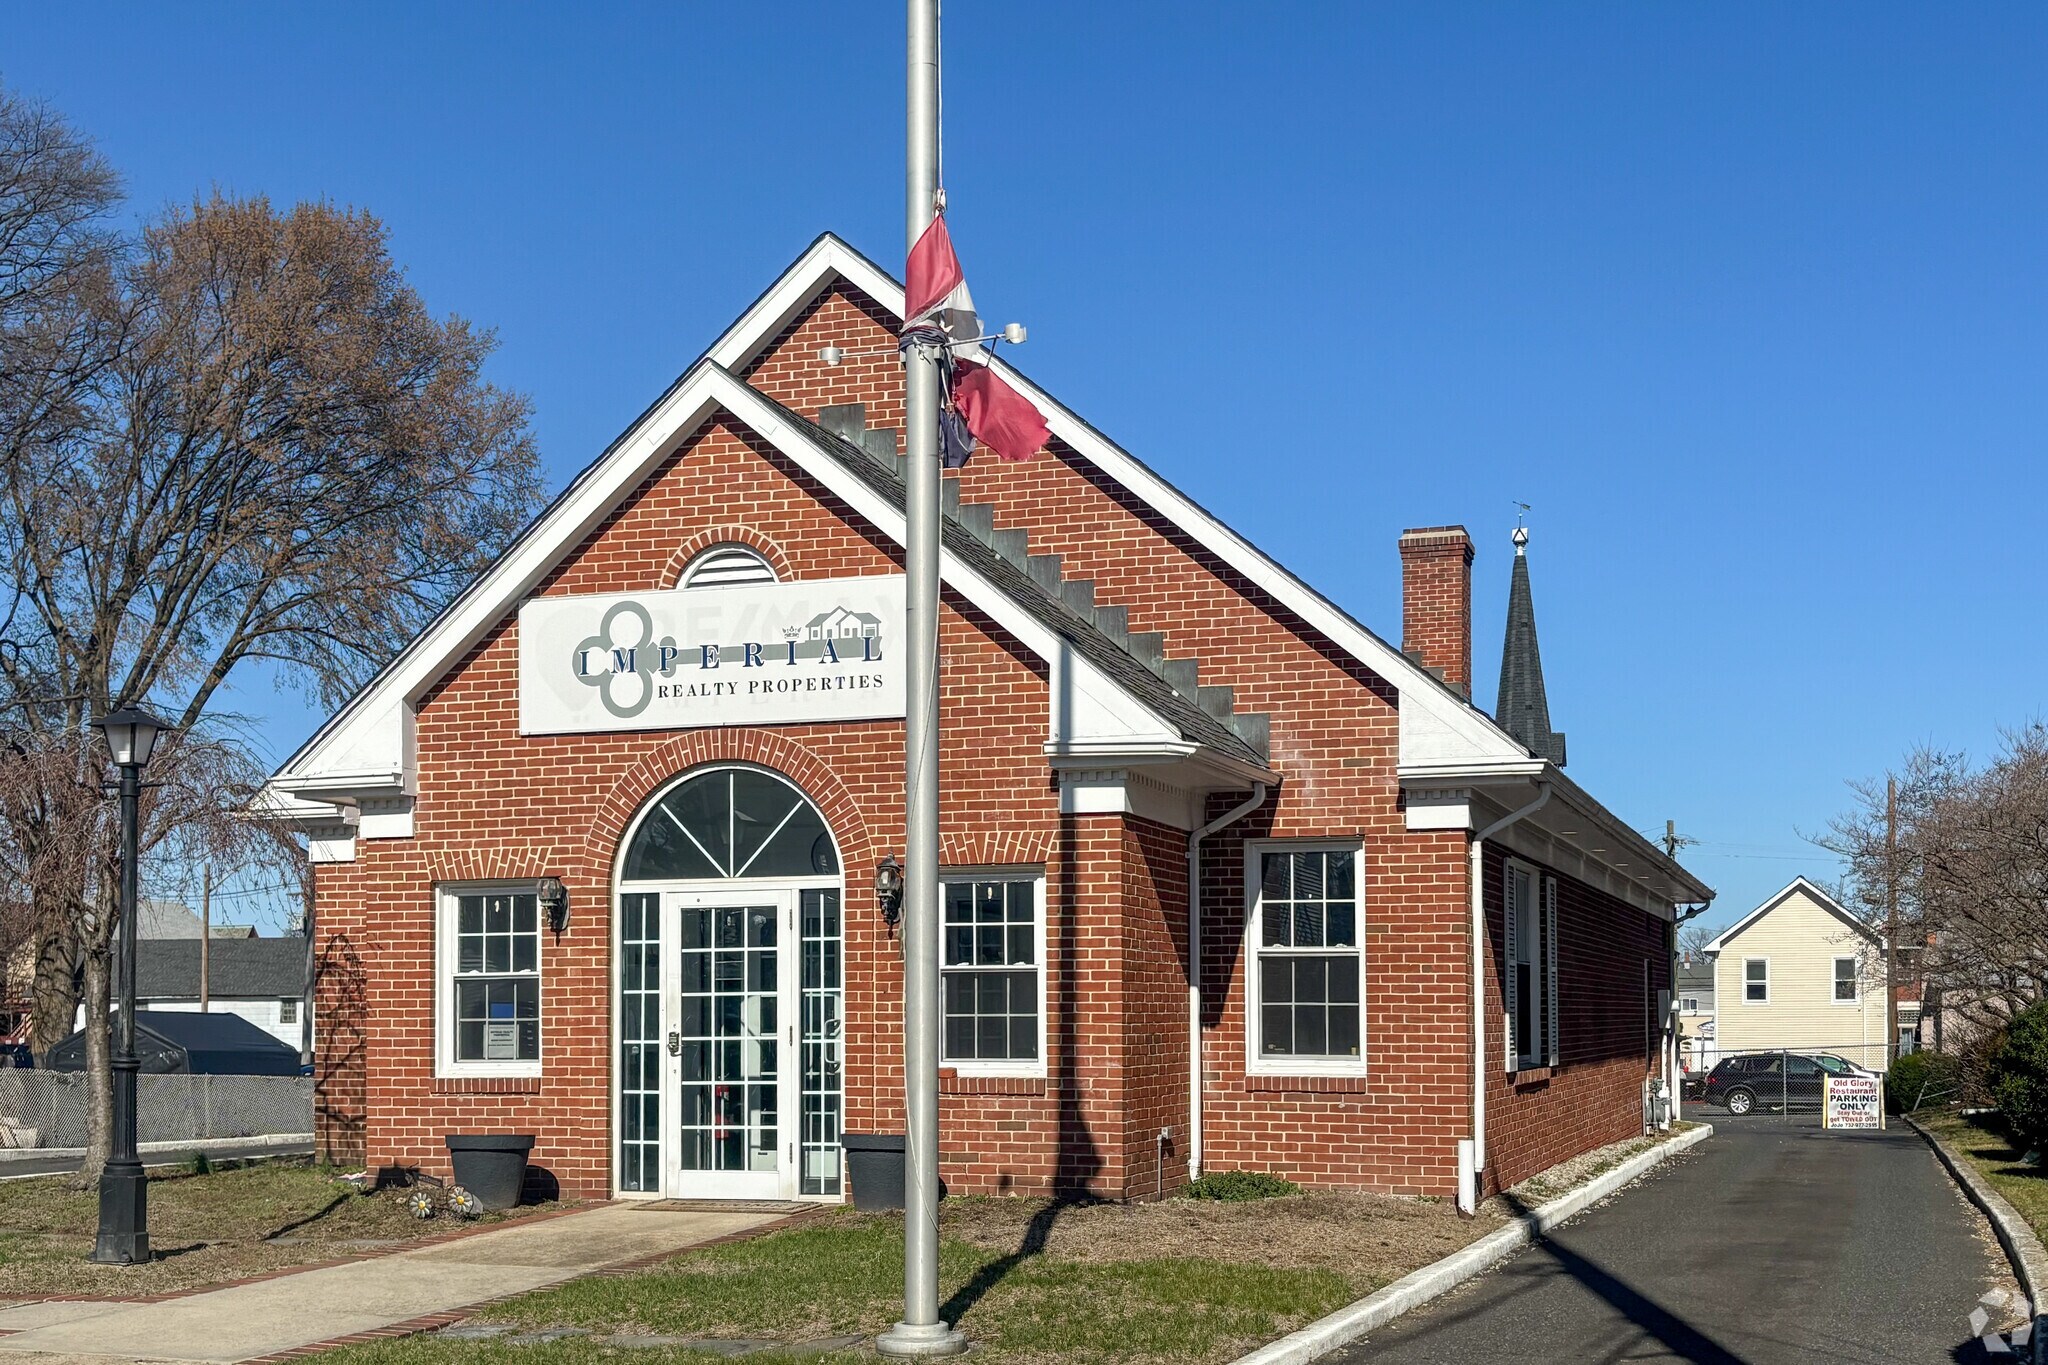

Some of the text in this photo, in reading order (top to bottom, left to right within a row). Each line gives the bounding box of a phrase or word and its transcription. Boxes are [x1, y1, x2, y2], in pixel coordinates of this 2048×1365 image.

[579, 636, 883, 676] IMPERIAL
[658, 674, 884, 698] REALTY PROPERTIES
[1833, 1079, 1873, 1088] Old Glory
